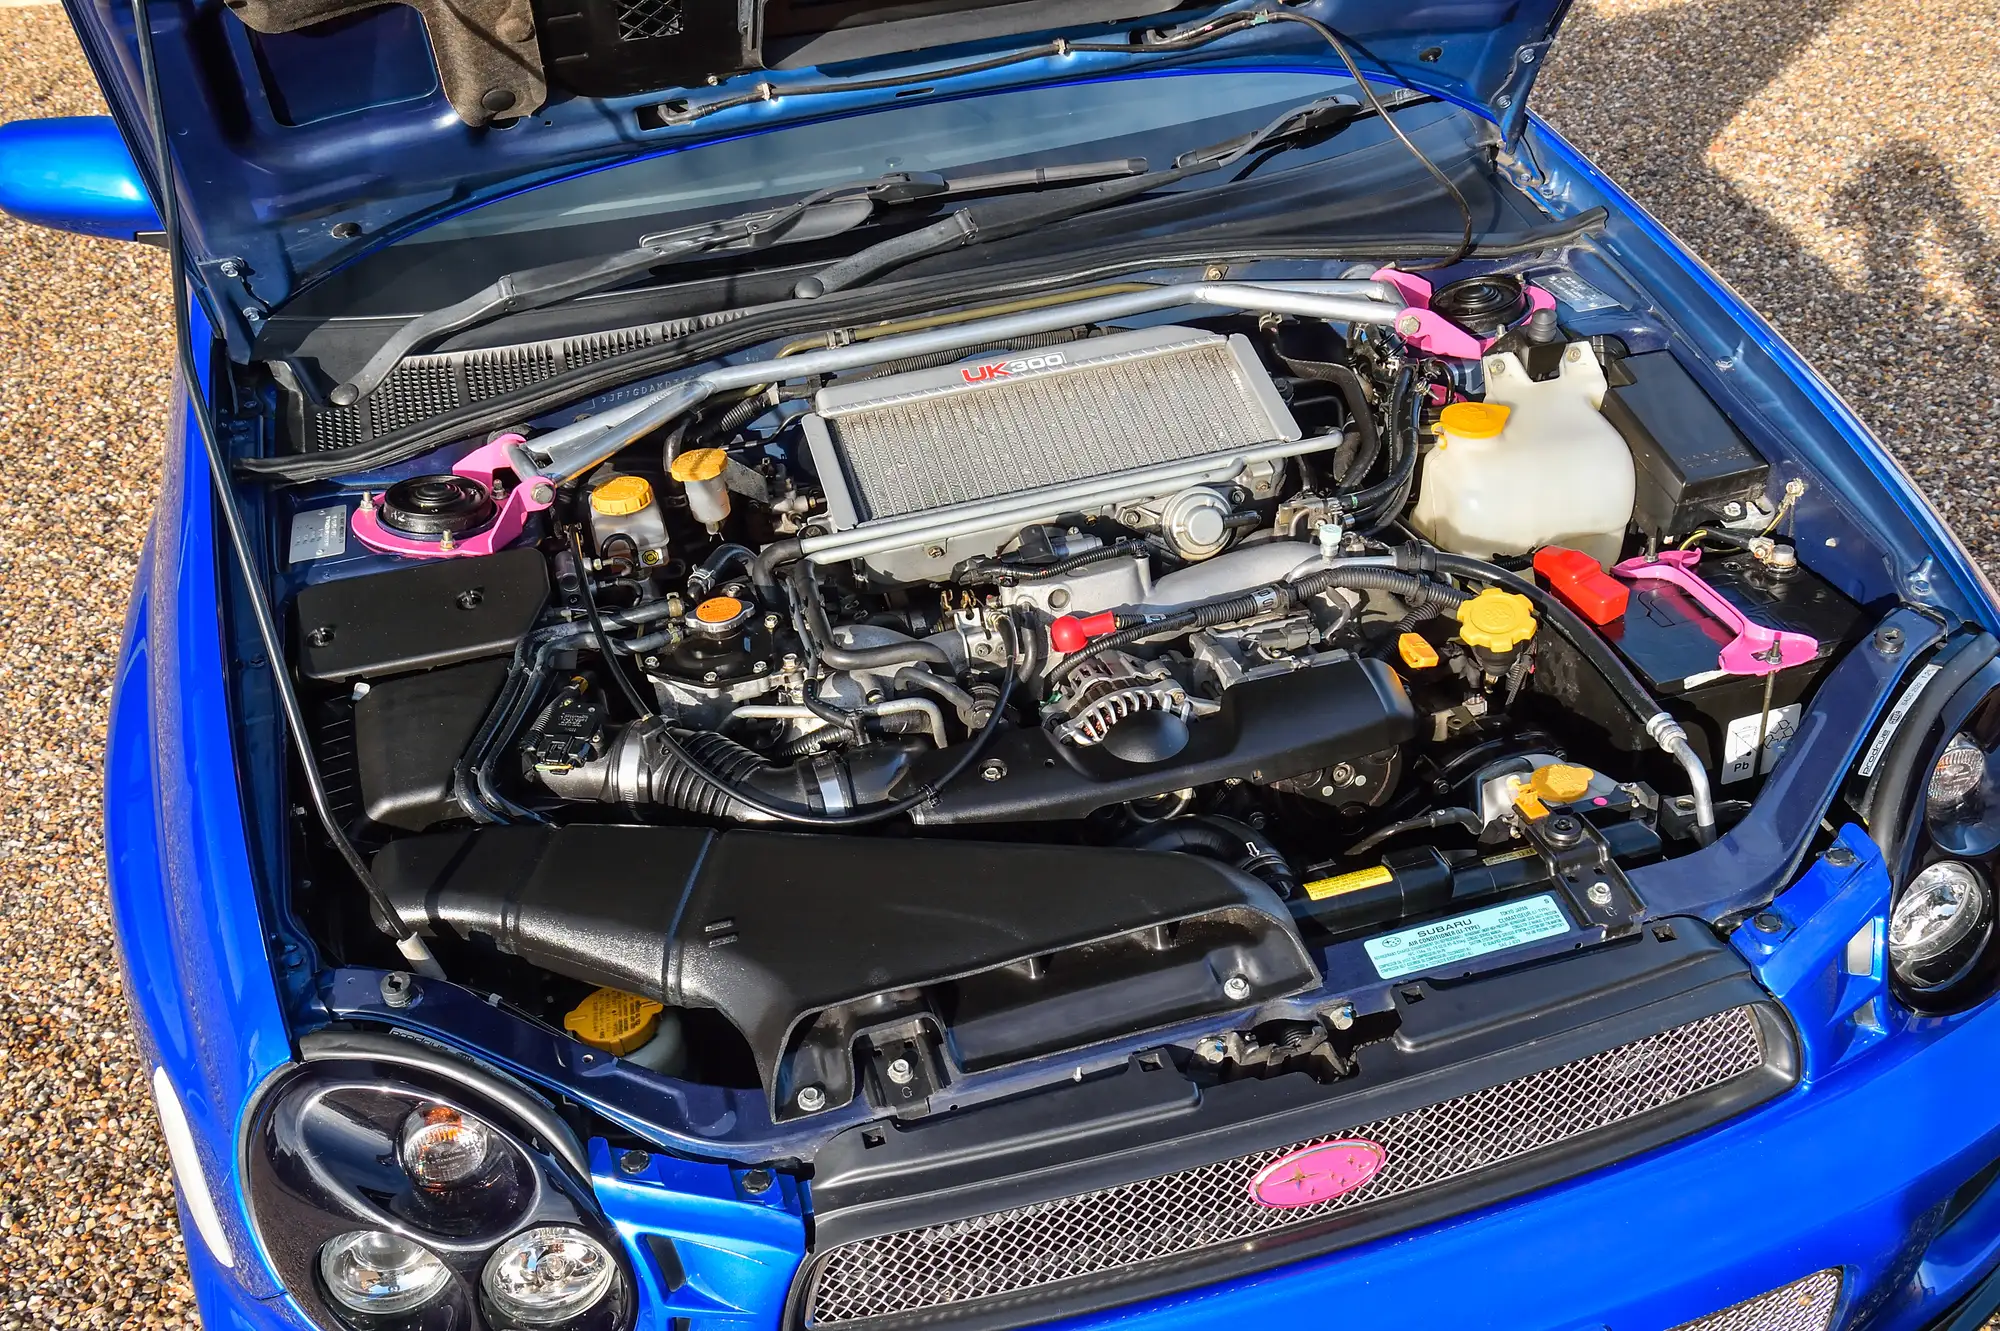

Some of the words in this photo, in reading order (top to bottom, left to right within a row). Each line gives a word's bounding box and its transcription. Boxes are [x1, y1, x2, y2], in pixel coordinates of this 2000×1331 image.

[961, 355, 1064, 382] UK300
[1734, 761, 1749, 773] Pb
[1417, 918, 1472, 937] SUBARU
[1408, 939, 1418, 947] AIR
[1419, 931, 1456, 945] CONDITIONER
[901, 1086, 913, 1099] G
